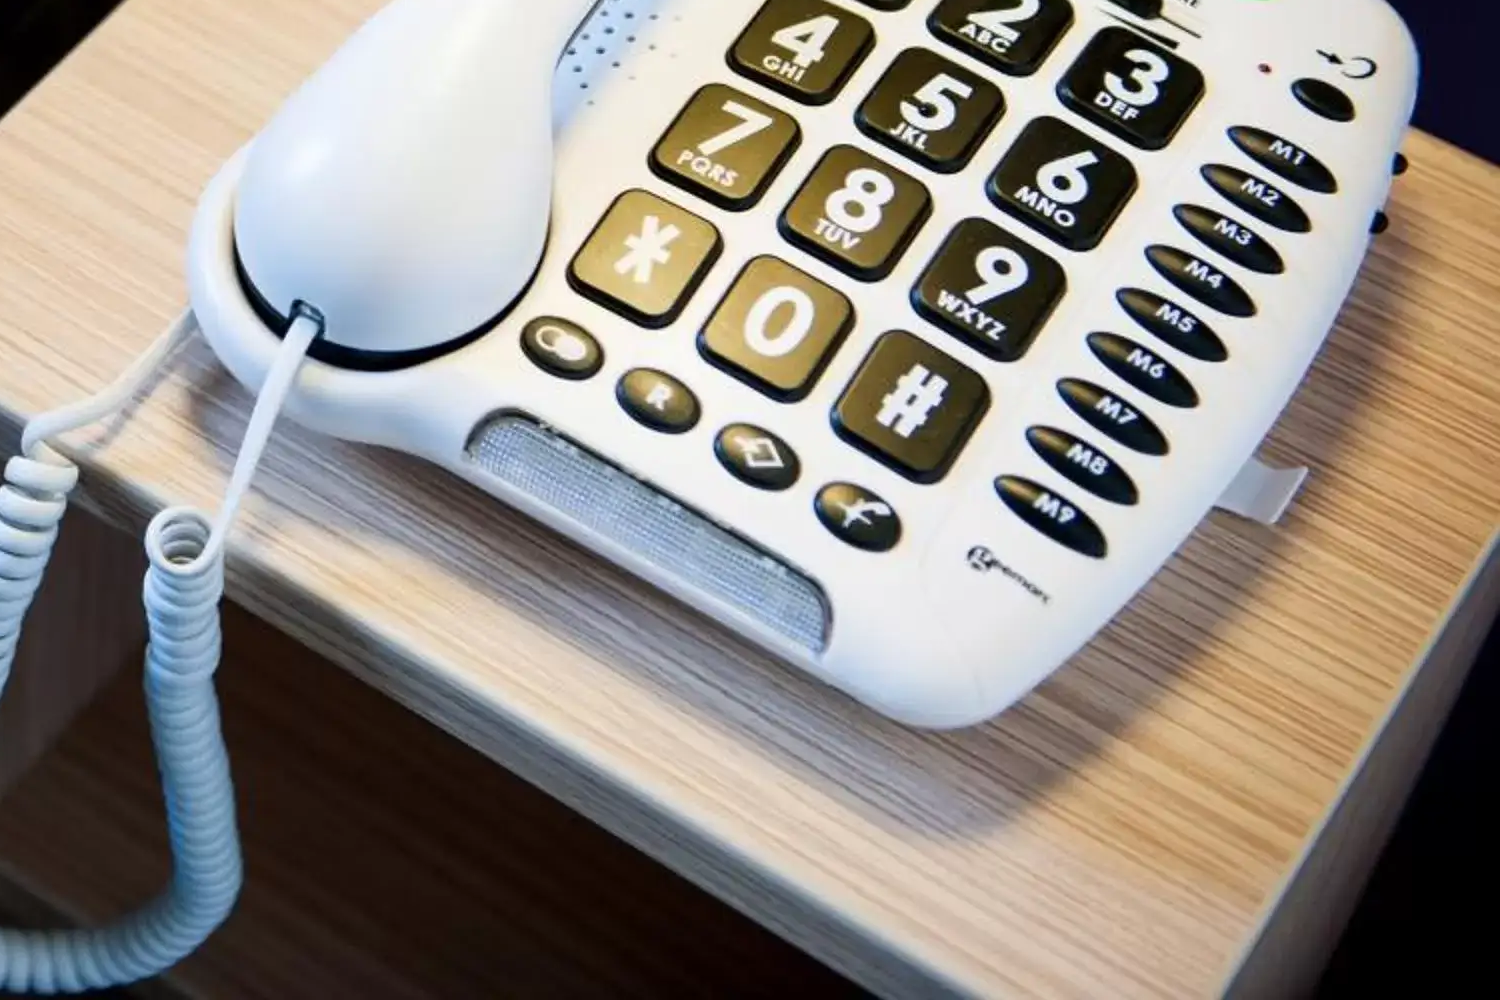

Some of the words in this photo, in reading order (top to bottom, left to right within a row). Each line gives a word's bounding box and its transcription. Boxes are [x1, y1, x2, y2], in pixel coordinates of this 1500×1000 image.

[771, 14, 840, 65] 4
[958, 23, 1012, 53] ABC
[762, 55, 806, 82] GHI
[1103, 49, 1169, 107] 3
[900, 73, 973, 131] 5
[1093, 91, 1140, 120] DEF
[697, 100, 773, 156] 7
[889, 126, 929, 151] JKL
[676, 150, 739, 187] PQRS
[1269, 140, 1306, 165] M1
[1036, 150, 1099, 204] 6
[1241, 178, 1281, 207] M2
[825, 167, 895, 233] 8
[1013, 185, 1076, 227] MNO
[813, 217, 862, 251] TUV
[1213, 219, 1251, 246] M3
[964, 246, 1029, 306] 9
[1183, 260, 1223, 289] M4
[743, 286, 814, 357] 0
[936, 290, 1008, 340] WXYZ
[1155, 303, 1196, 333] M5
[1126, 348, 1167, 378] M6
[645, 383, 673, 411] R
[876, 363, 948, 439] #
[1095, 396, 1139, 425] M7
[1065, 443, 1109, 475] M8
[1033, 493, 1076, 523] M9
